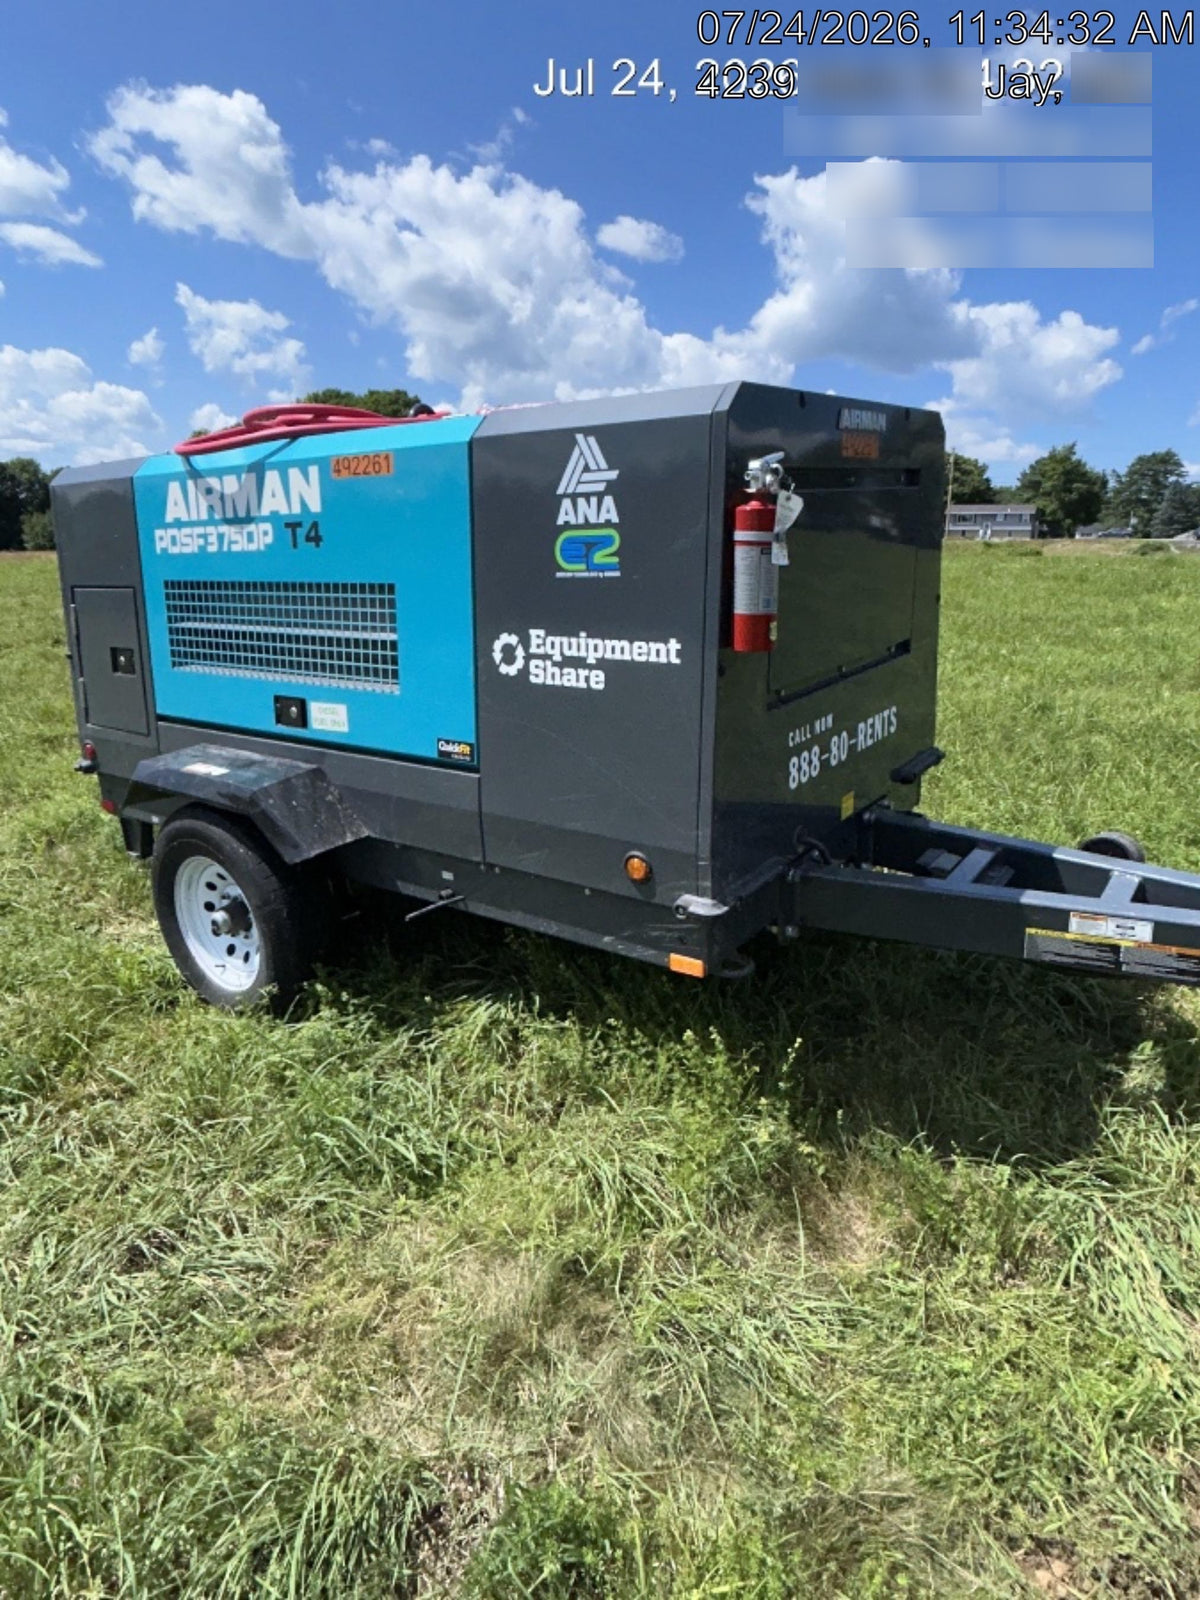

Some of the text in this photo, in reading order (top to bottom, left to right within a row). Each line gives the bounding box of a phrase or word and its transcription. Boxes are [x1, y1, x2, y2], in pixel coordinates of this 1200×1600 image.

[333, 453, 391, 477] 492261
[165, 465, 322, 523] AIRMAN
[556, 496, 620, 525] ANA
[284, 520, 323, 549] T4
[529, 629, 682, 664] Equipment
[529, 659, 605, 690] Share
[788, 723, 812, 748] CALL
[788, 705, 897, 790] 888-80-RENTS
